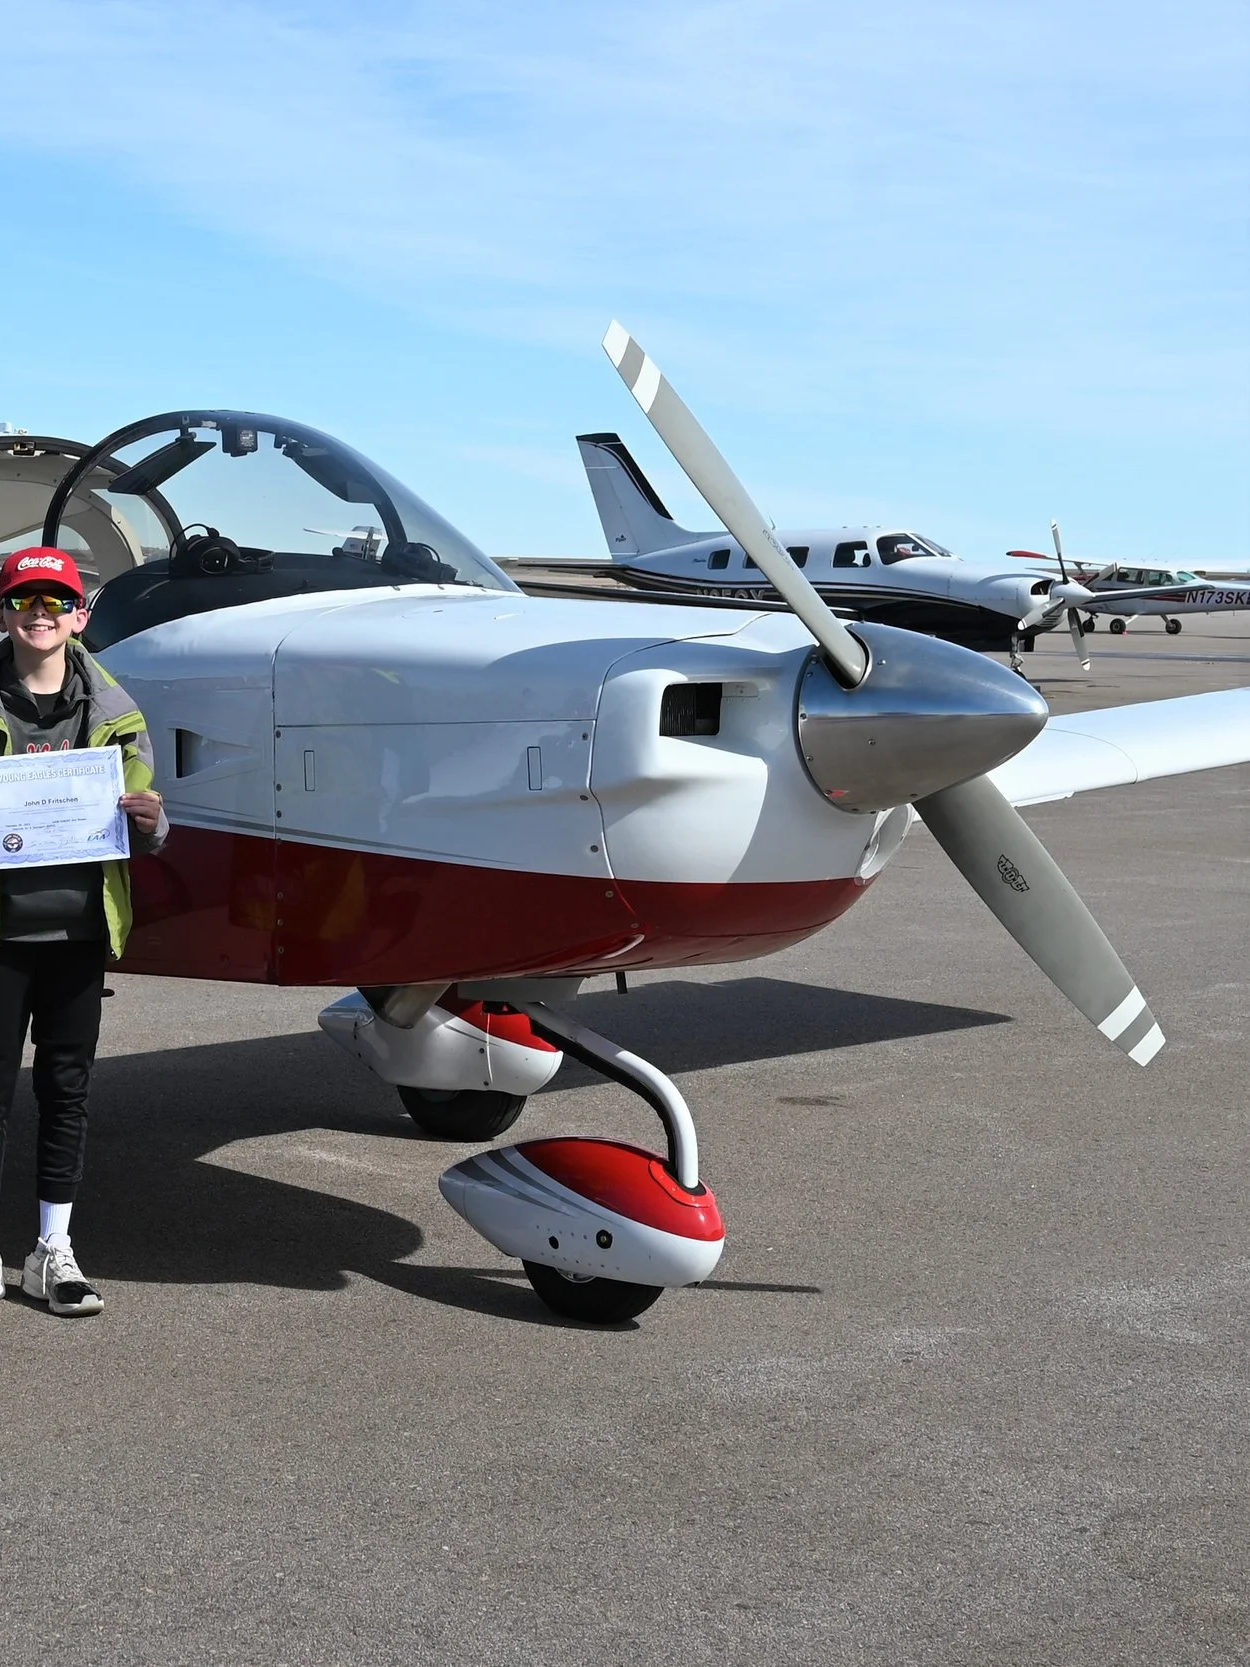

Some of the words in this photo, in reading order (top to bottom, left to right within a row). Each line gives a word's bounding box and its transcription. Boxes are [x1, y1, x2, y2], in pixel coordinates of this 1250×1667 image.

[1185, 590, 1250, 606] N173SK
[27, 769, 57, 781] EAGLES
[57, 765, 106, 778] CERTIFICATE
